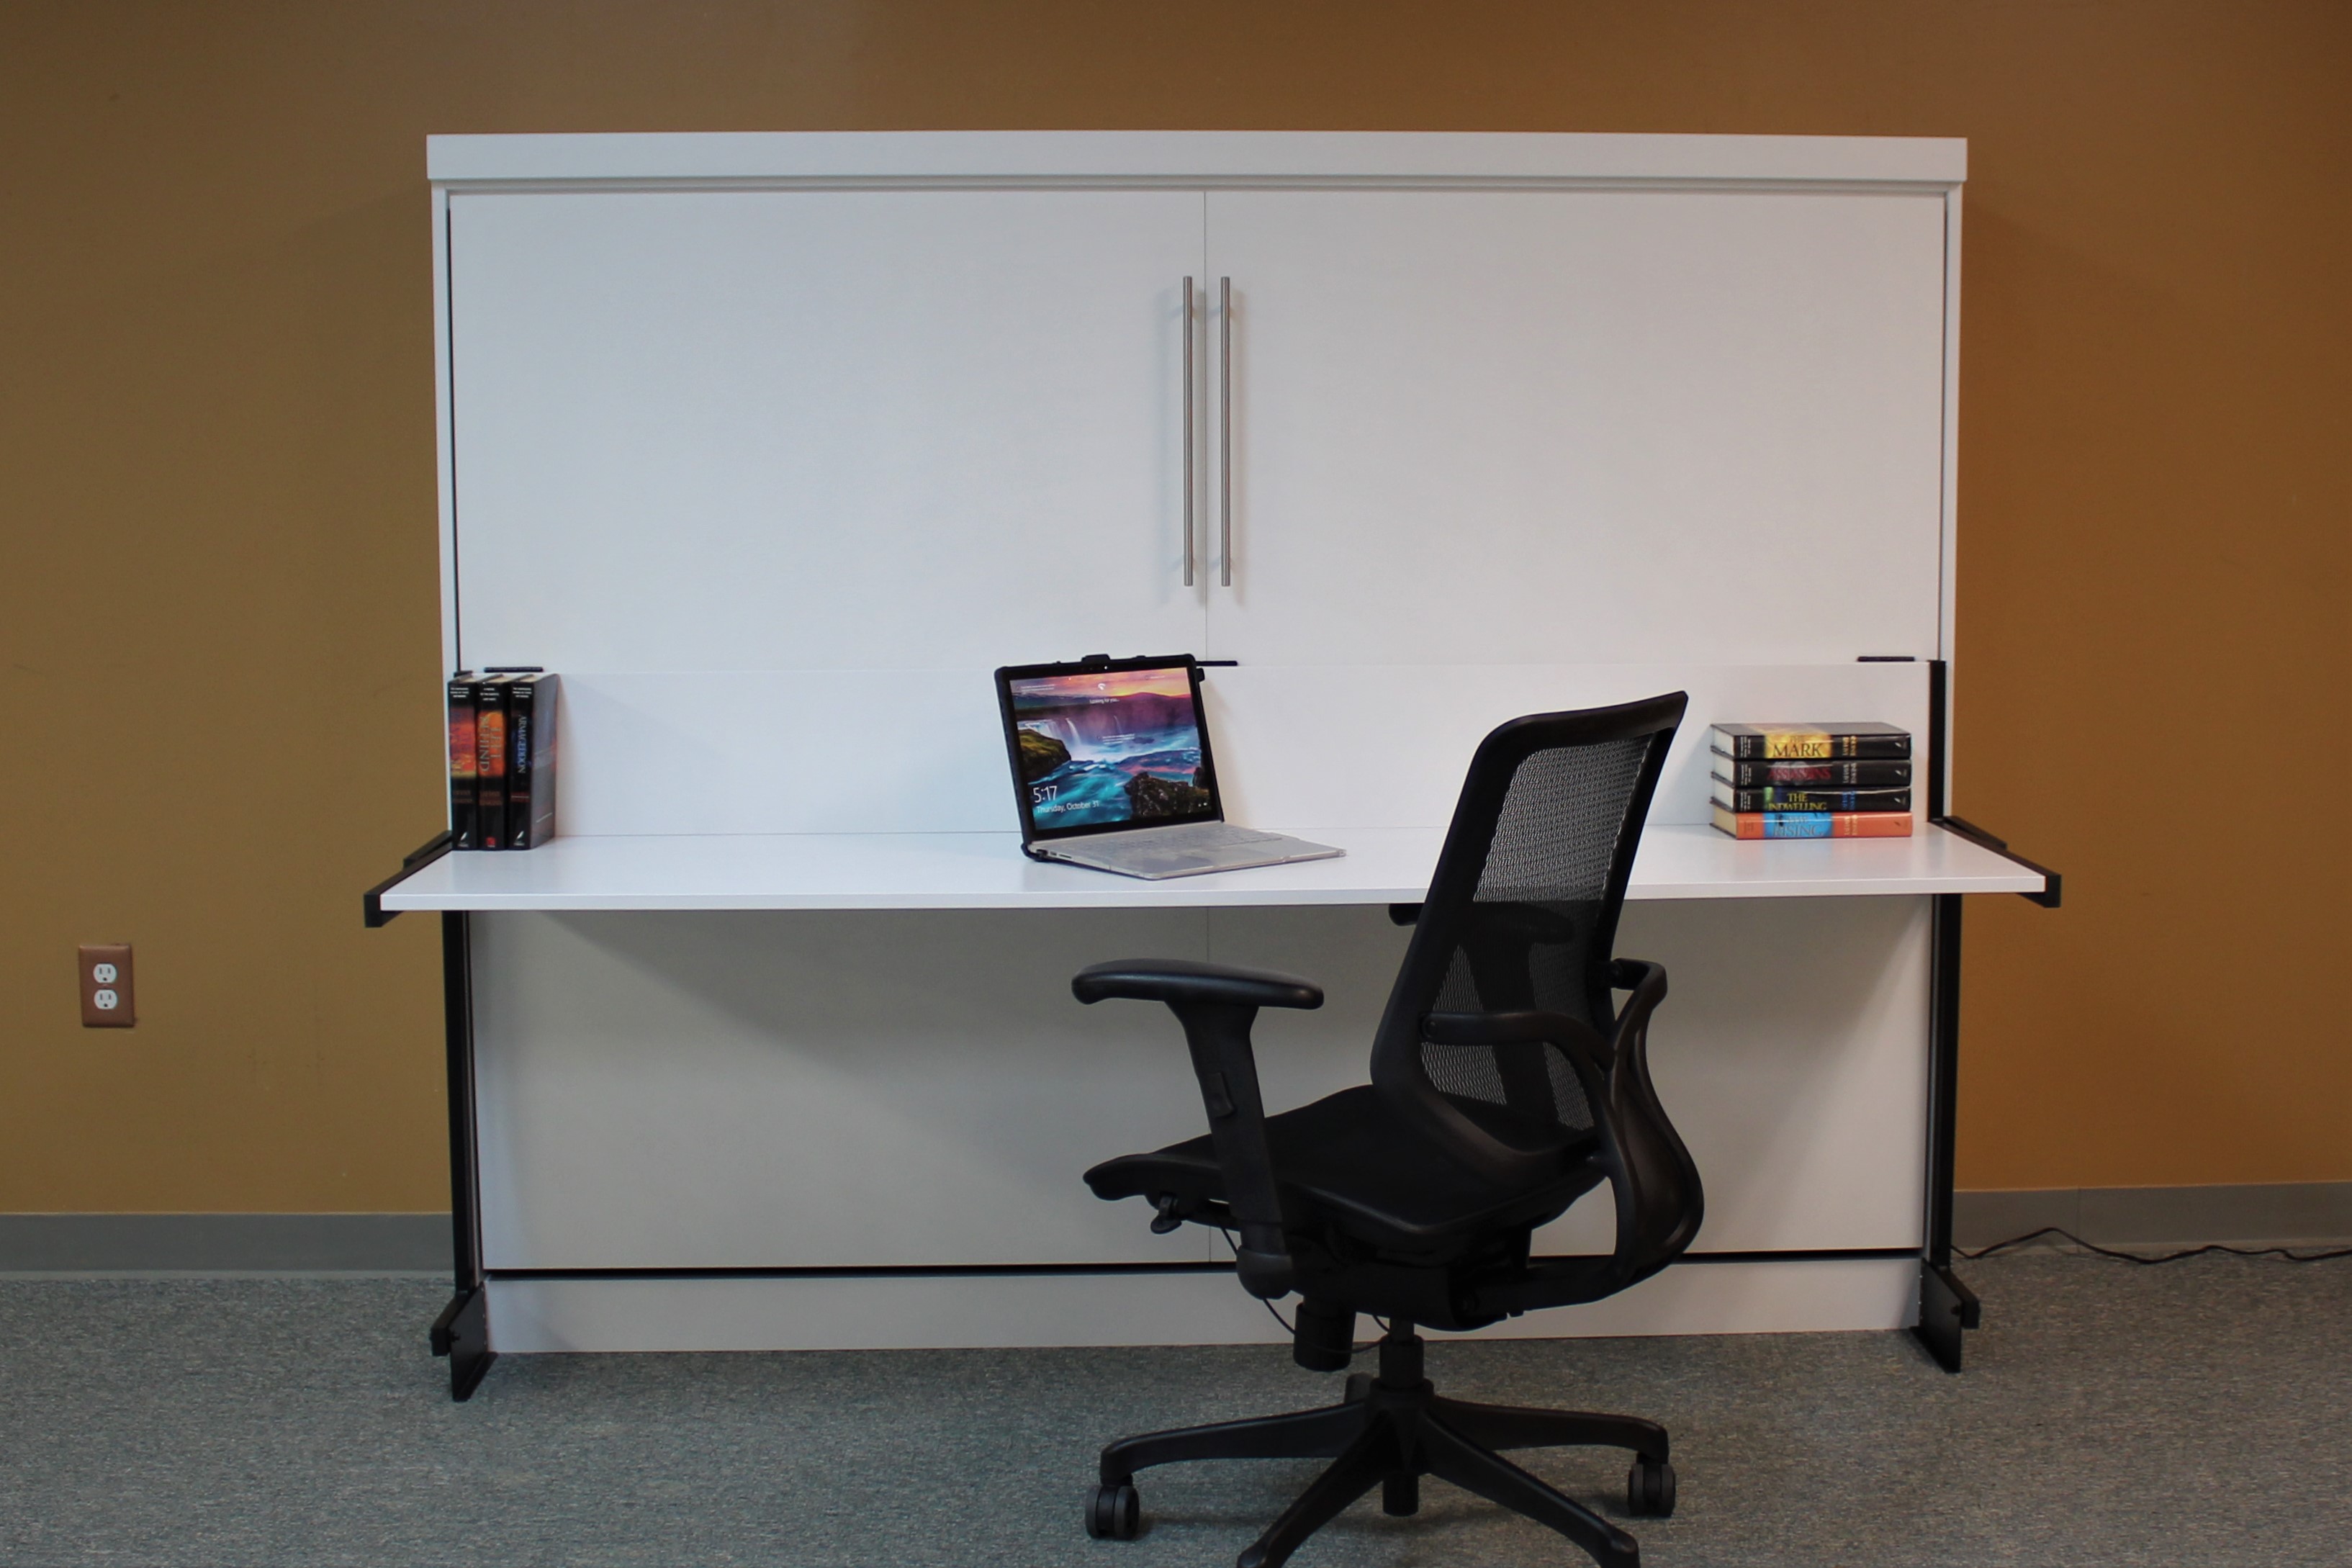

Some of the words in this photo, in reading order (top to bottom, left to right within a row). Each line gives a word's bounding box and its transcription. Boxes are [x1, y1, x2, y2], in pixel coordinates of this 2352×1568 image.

[1772, 742, 1824, 757] MARK
[1767, 767, 1831, 780] ASSASSINS
[1032, 785, 1058, 803] 5:17
[1787, 792, 1808, 802] THE
[1037, 803, 1065, 814] Thursday,
[1066, 801, 1091, 811] October
[1767, 802, 1827, 811] INDWELLING
